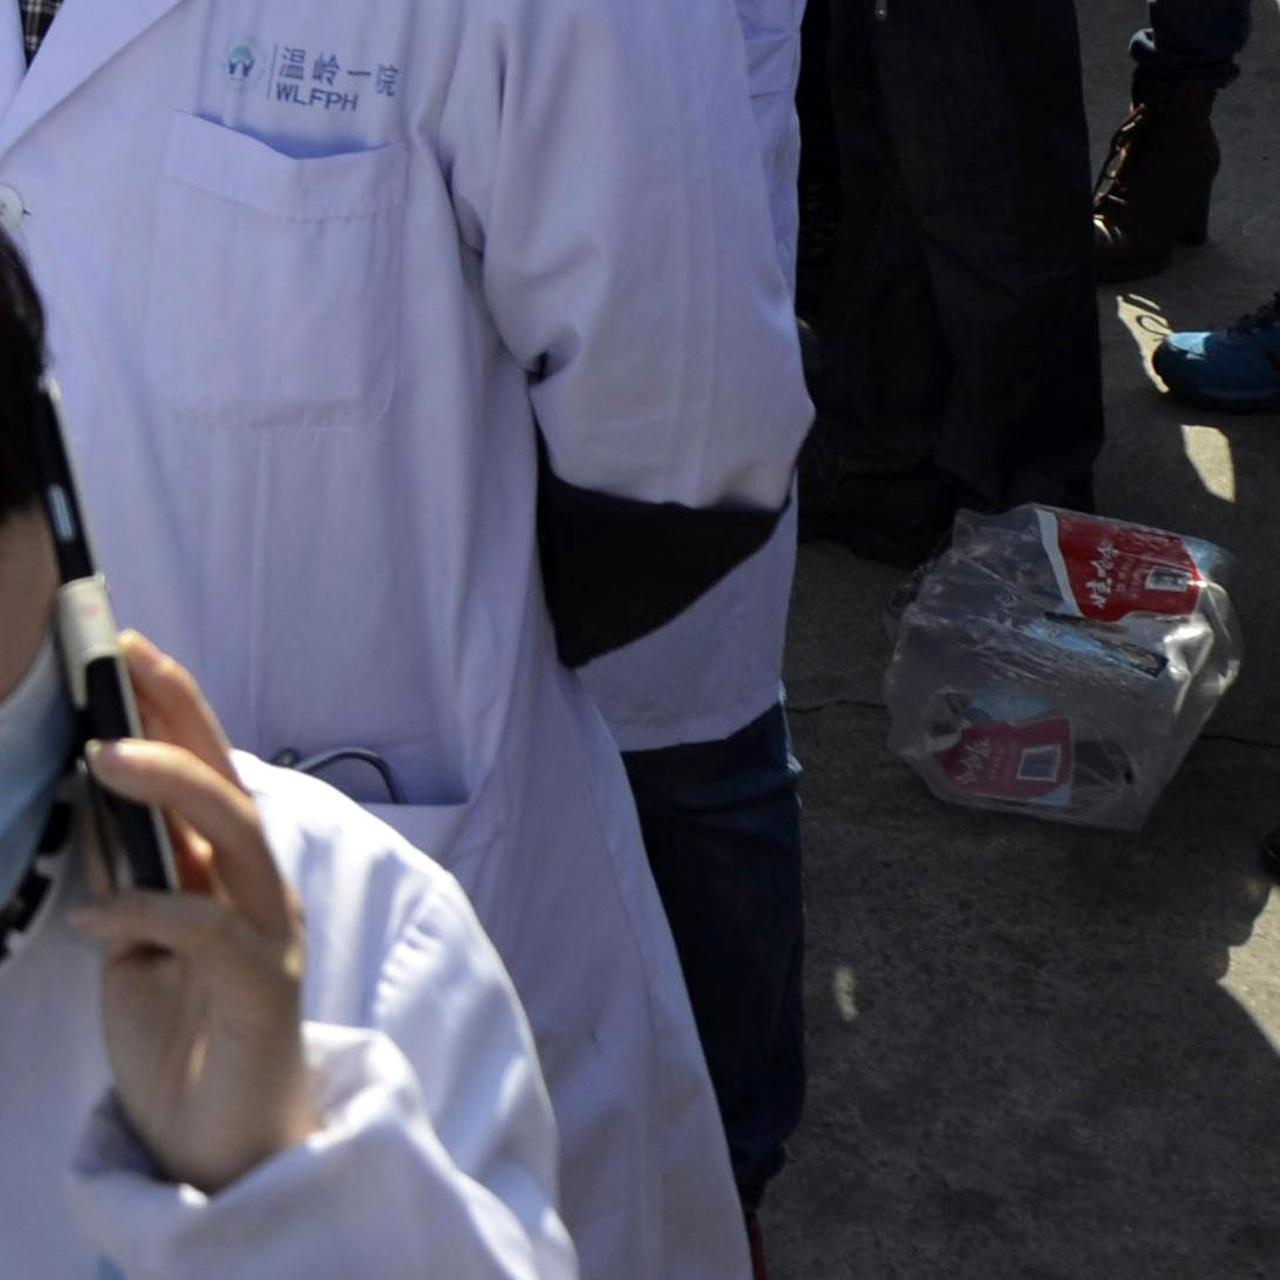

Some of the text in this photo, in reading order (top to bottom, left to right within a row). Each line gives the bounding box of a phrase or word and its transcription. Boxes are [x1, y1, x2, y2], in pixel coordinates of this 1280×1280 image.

[278, 46, 402, 97] 温岭一院
[275, 82, 360, 113] WLFPH
